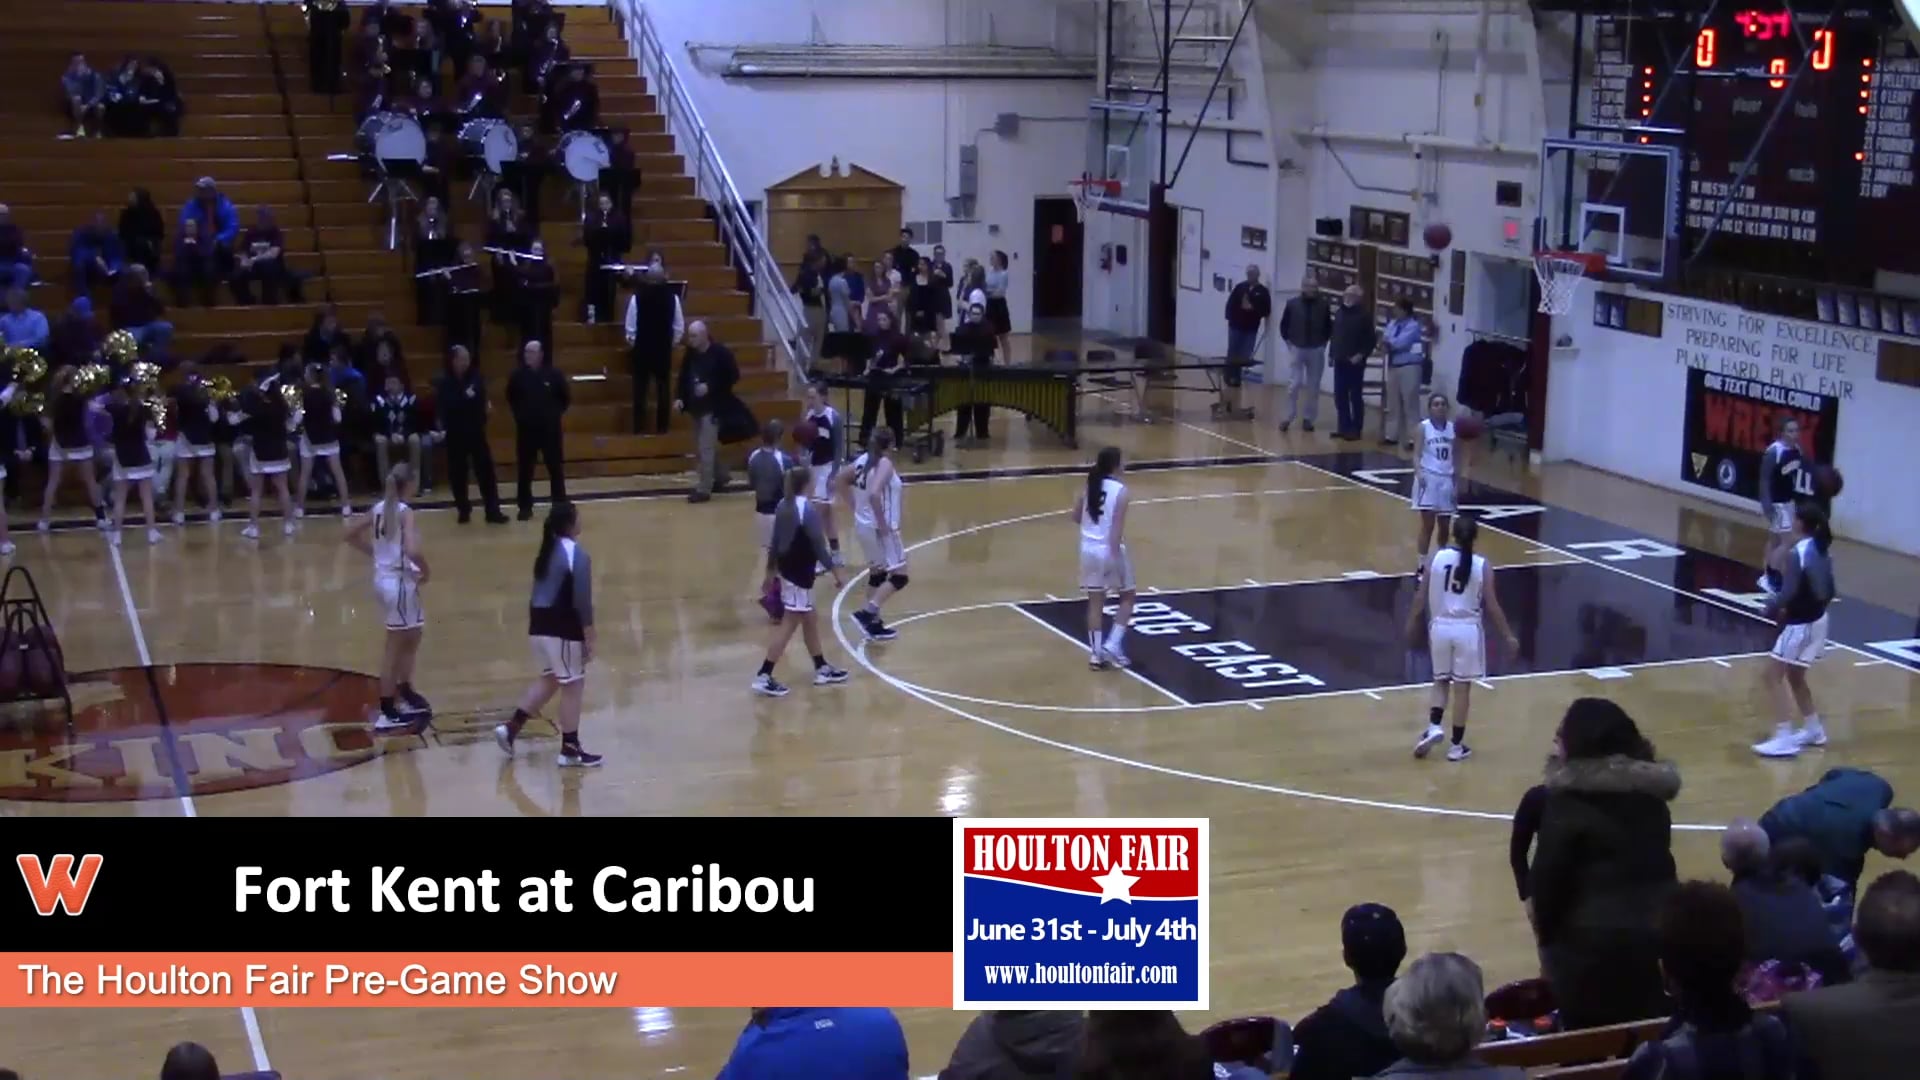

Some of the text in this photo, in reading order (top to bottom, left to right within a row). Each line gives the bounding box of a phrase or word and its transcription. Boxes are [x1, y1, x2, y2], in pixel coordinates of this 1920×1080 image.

[1696, 29, 1715, 67] 0
[1667, 303, 1727, 328] STRIVING
[1738, 314, 1765, 336] FOR
[1686, 328, 1846, 374] PREPARING FOR LIFE
[1676, 349, 1854, 400] PLAY HARD PLAY FAIR
[1724, 378, 1747, 396] TEXT
[1763, 385, 1787, 405] CALL
[1435, 447, 1449, 461] 10
[1171, 640, 1326, 688] EAST
